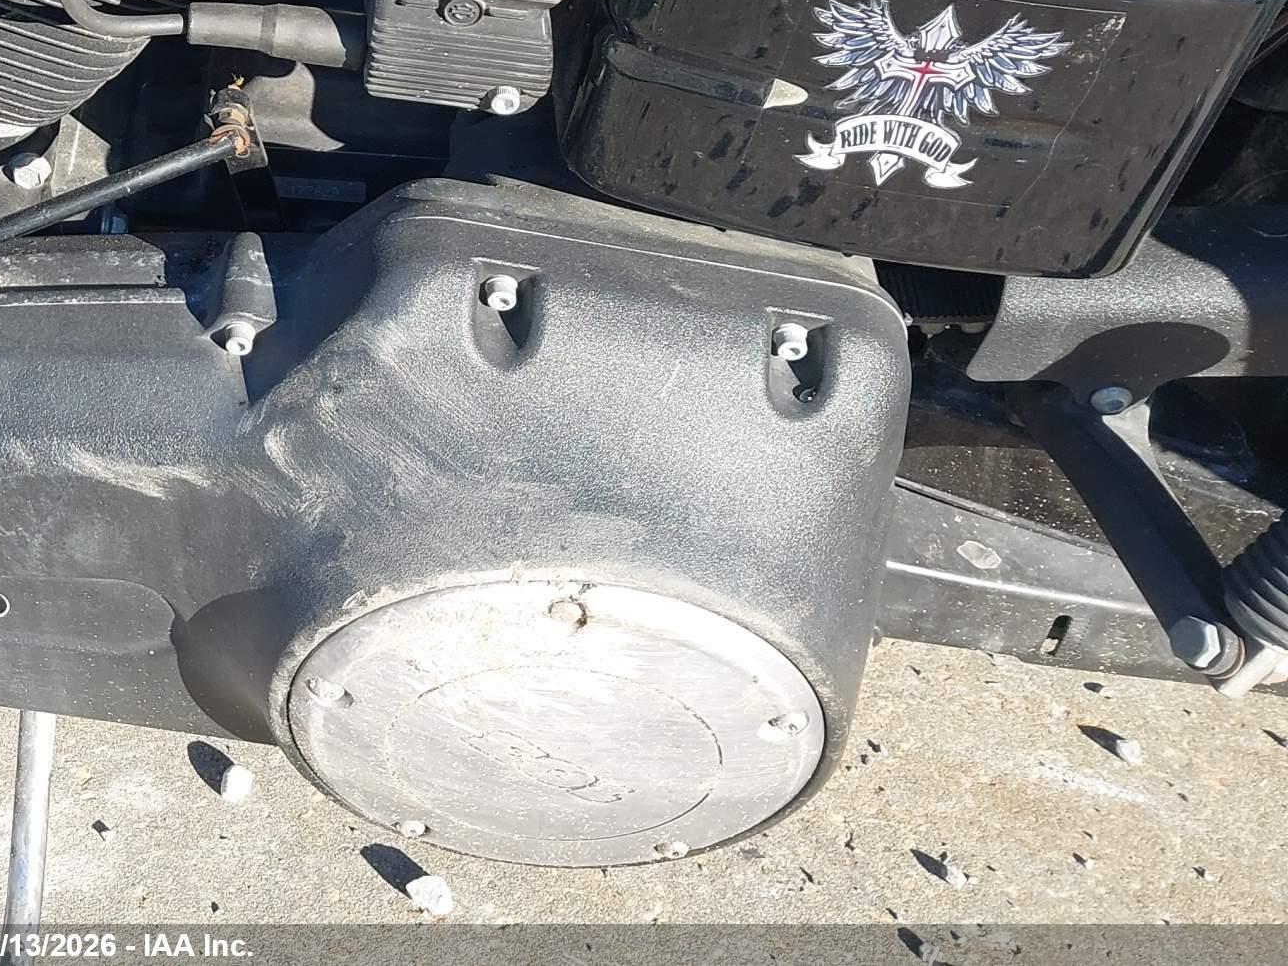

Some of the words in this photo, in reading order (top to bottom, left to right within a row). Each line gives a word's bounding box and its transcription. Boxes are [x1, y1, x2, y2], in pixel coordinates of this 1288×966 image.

[840, 121, 878, 148] RIDE
[883, 120, 923, 149] WITH
[918, 131, 952, 162] GOD
